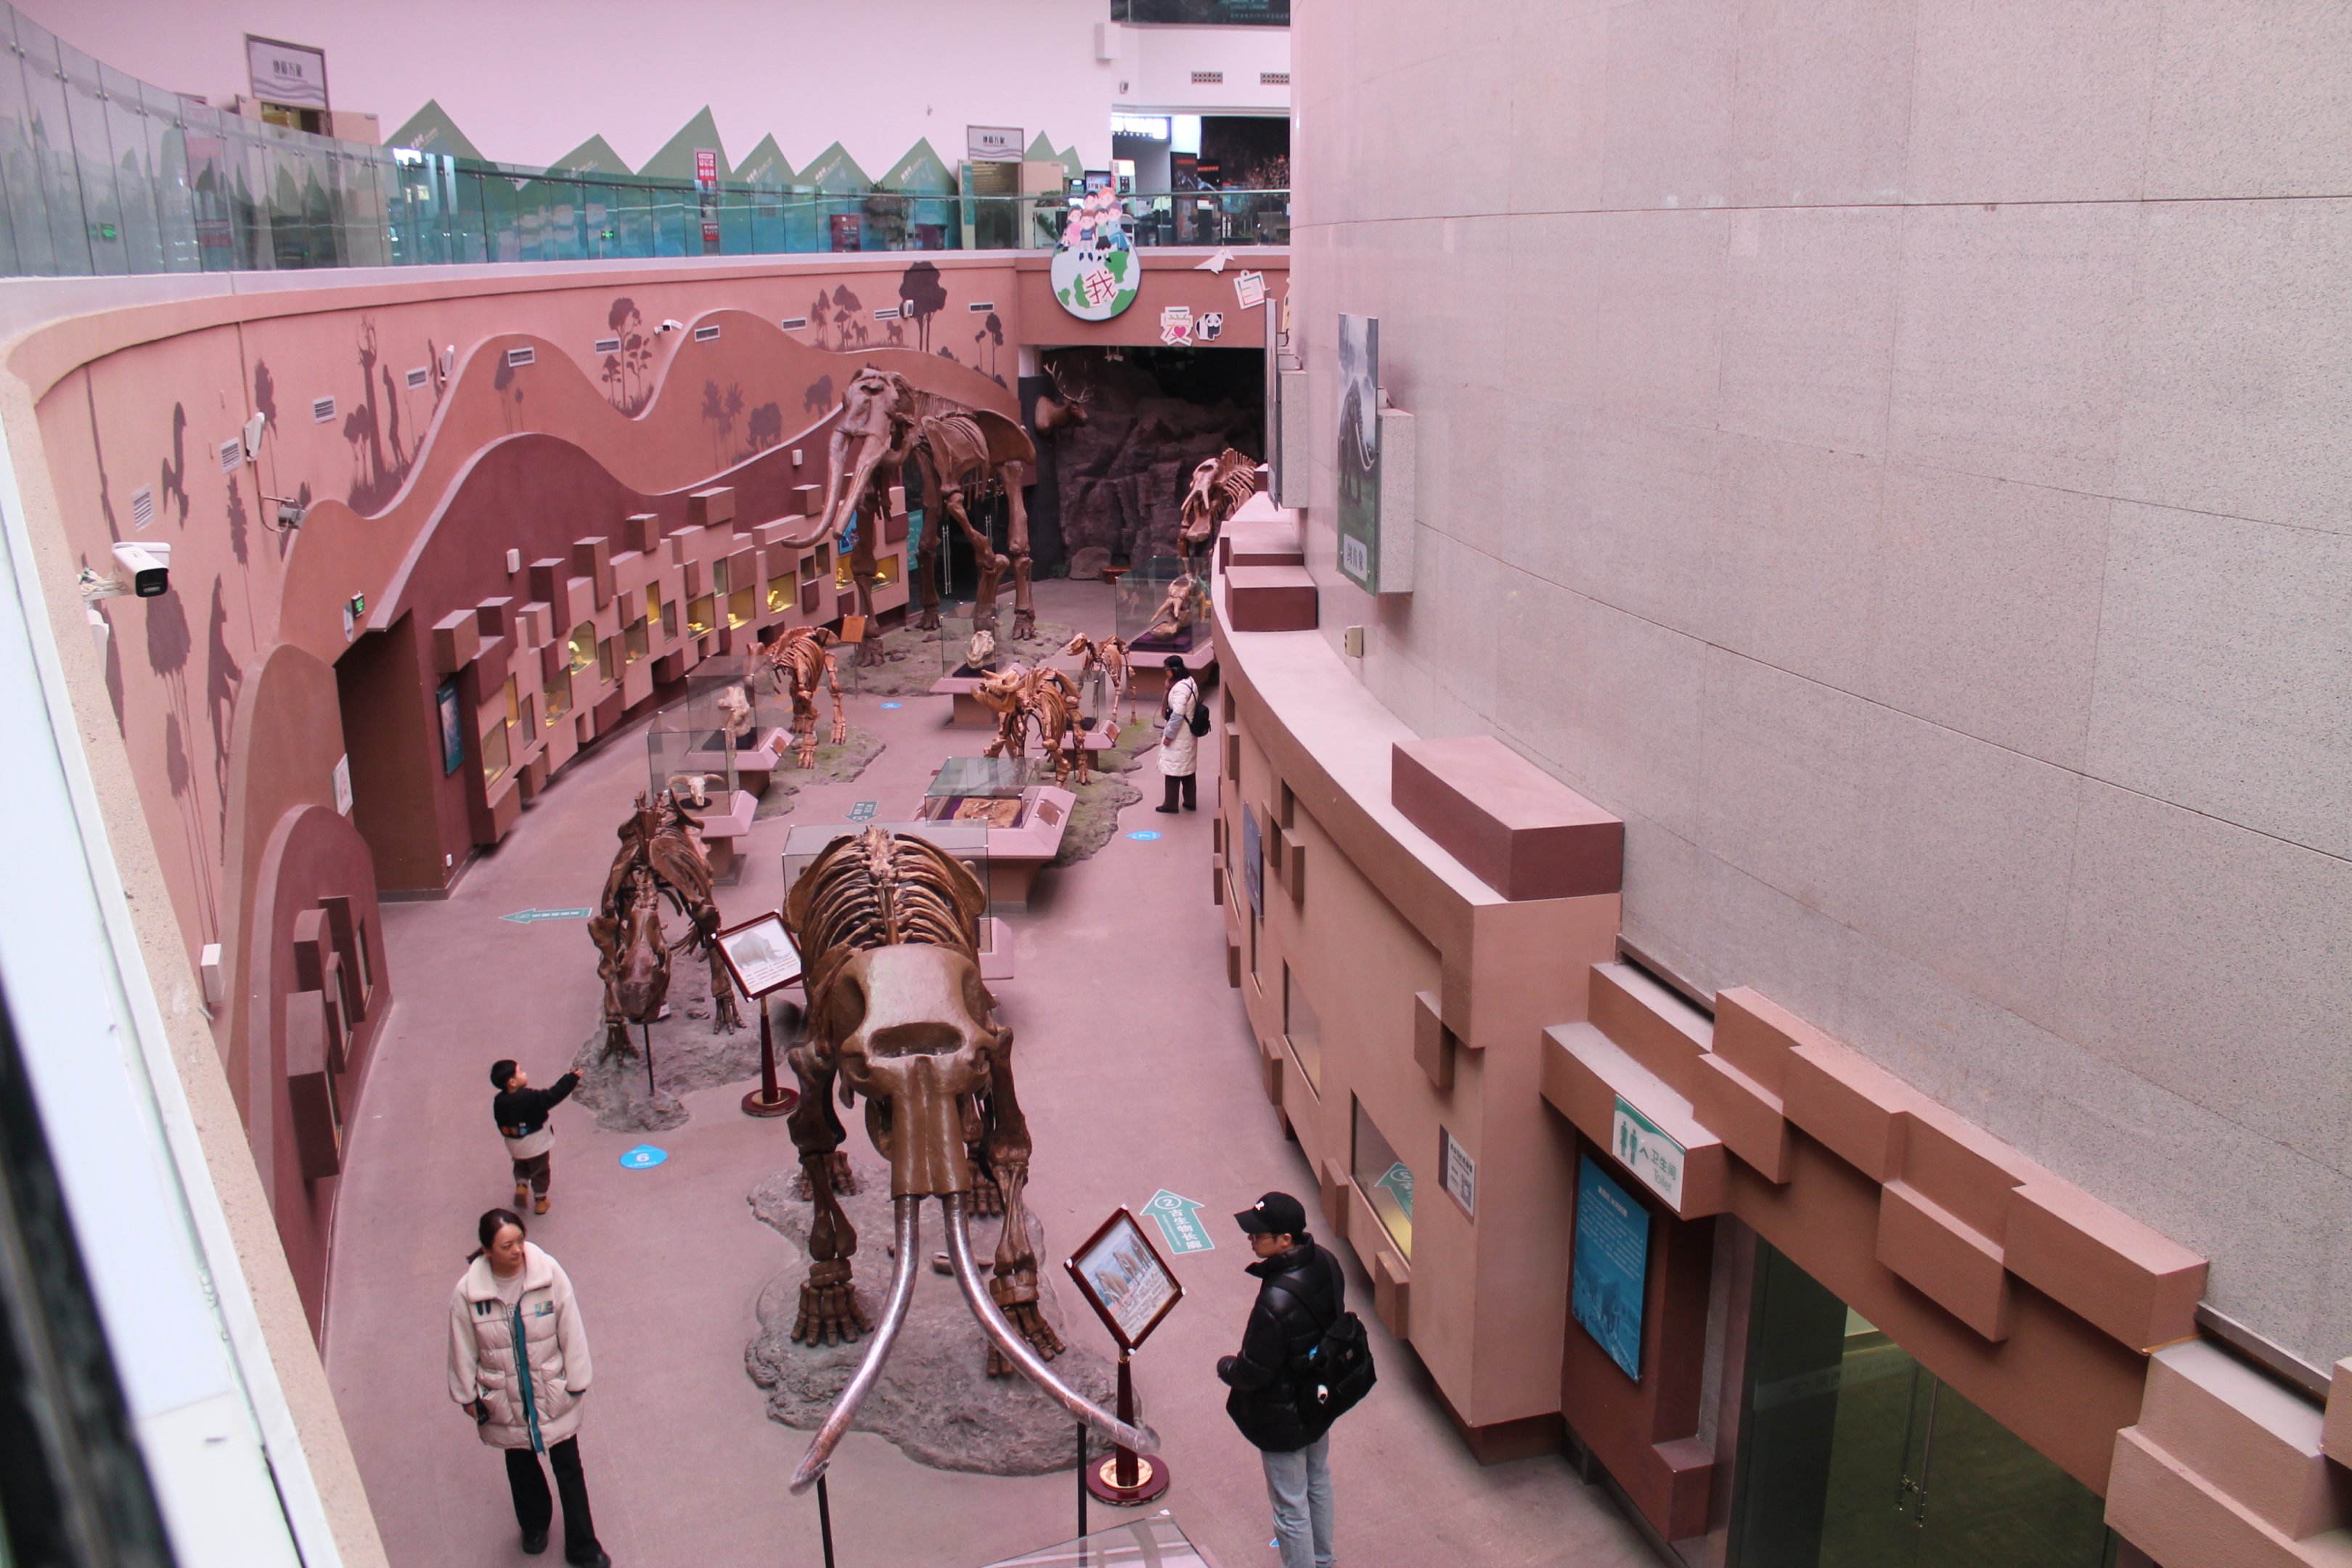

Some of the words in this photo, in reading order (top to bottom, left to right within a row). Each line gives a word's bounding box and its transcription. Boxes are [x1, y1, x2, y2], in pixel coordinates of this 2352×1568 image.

[1085, 269, 1117, 306] 我
[1651, 1148, 1677, 1181] 卫生间
[1654, 1168, 1672, 1193] Toilet
[1168, 1209, 1203, 1249] 古生物长廊
